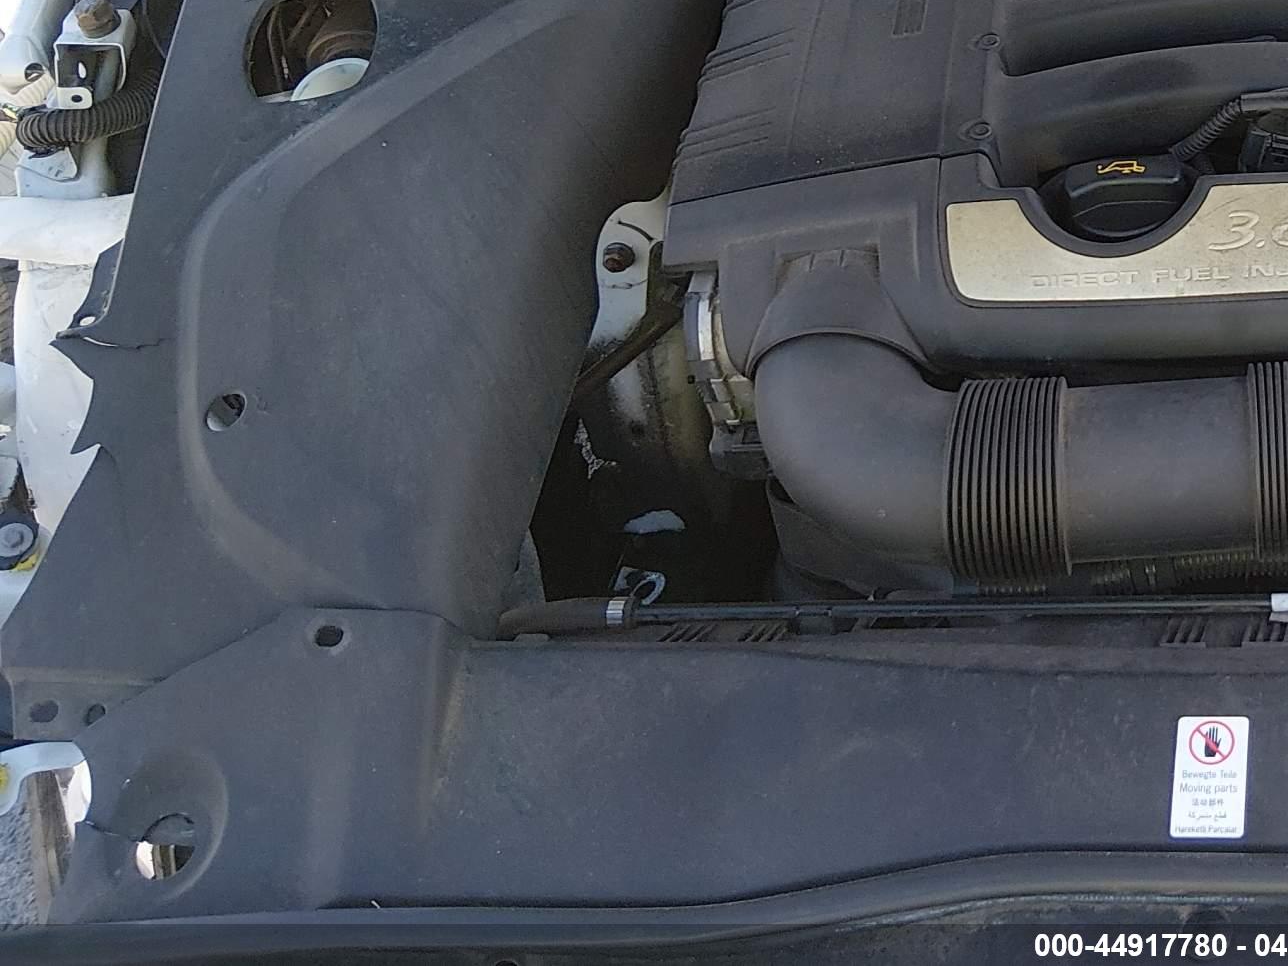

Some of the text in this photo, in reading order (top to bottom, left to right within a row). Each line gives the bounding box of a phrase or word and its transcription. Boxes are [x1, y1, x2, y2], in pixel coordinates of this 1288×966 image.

[1030, 269, 1140, 289] DIRECT
[1152, 265, 1232, 284] FUEL
[1181, 769, 1237, 780] Bewegte Teile
[1179, 783, 1238, 795] Moving parts
